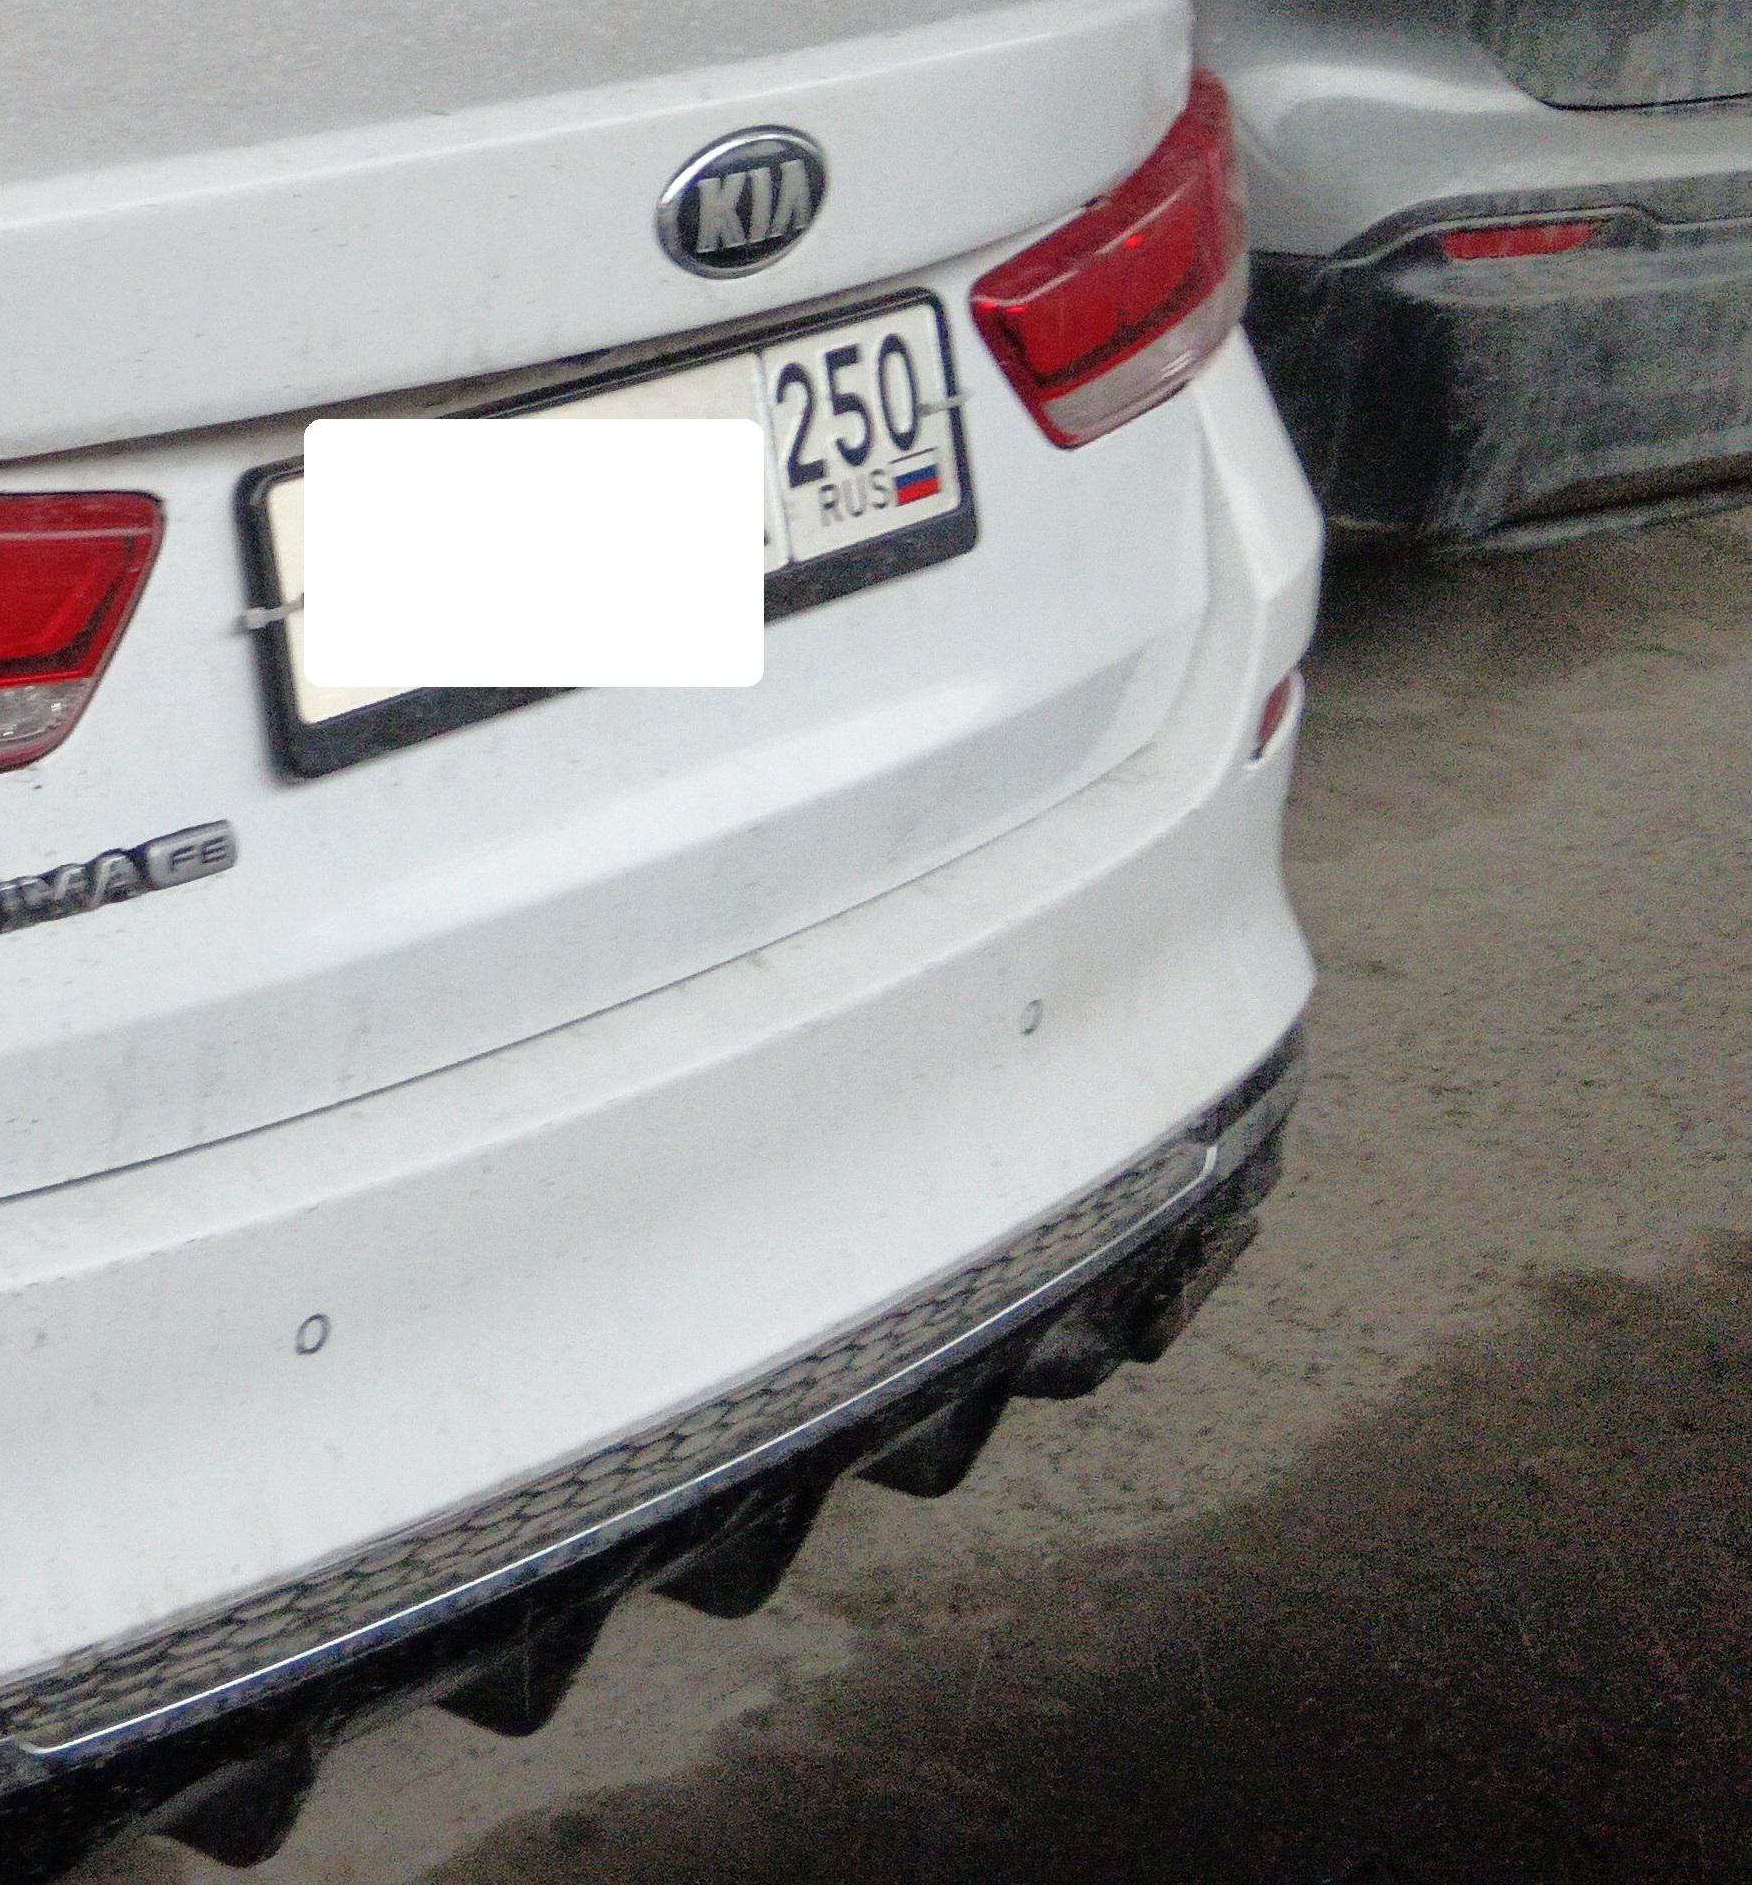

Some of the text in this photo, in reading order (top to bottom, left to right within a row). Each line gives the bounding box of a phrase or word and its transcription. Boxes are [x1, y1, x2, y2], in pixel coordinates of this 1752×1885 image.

[695, 156, 814, 253] KIA
[775, 332, 920, 490] 250
[818, 467, 891, 527] RUS
[163, 829, 233, 877] FE
